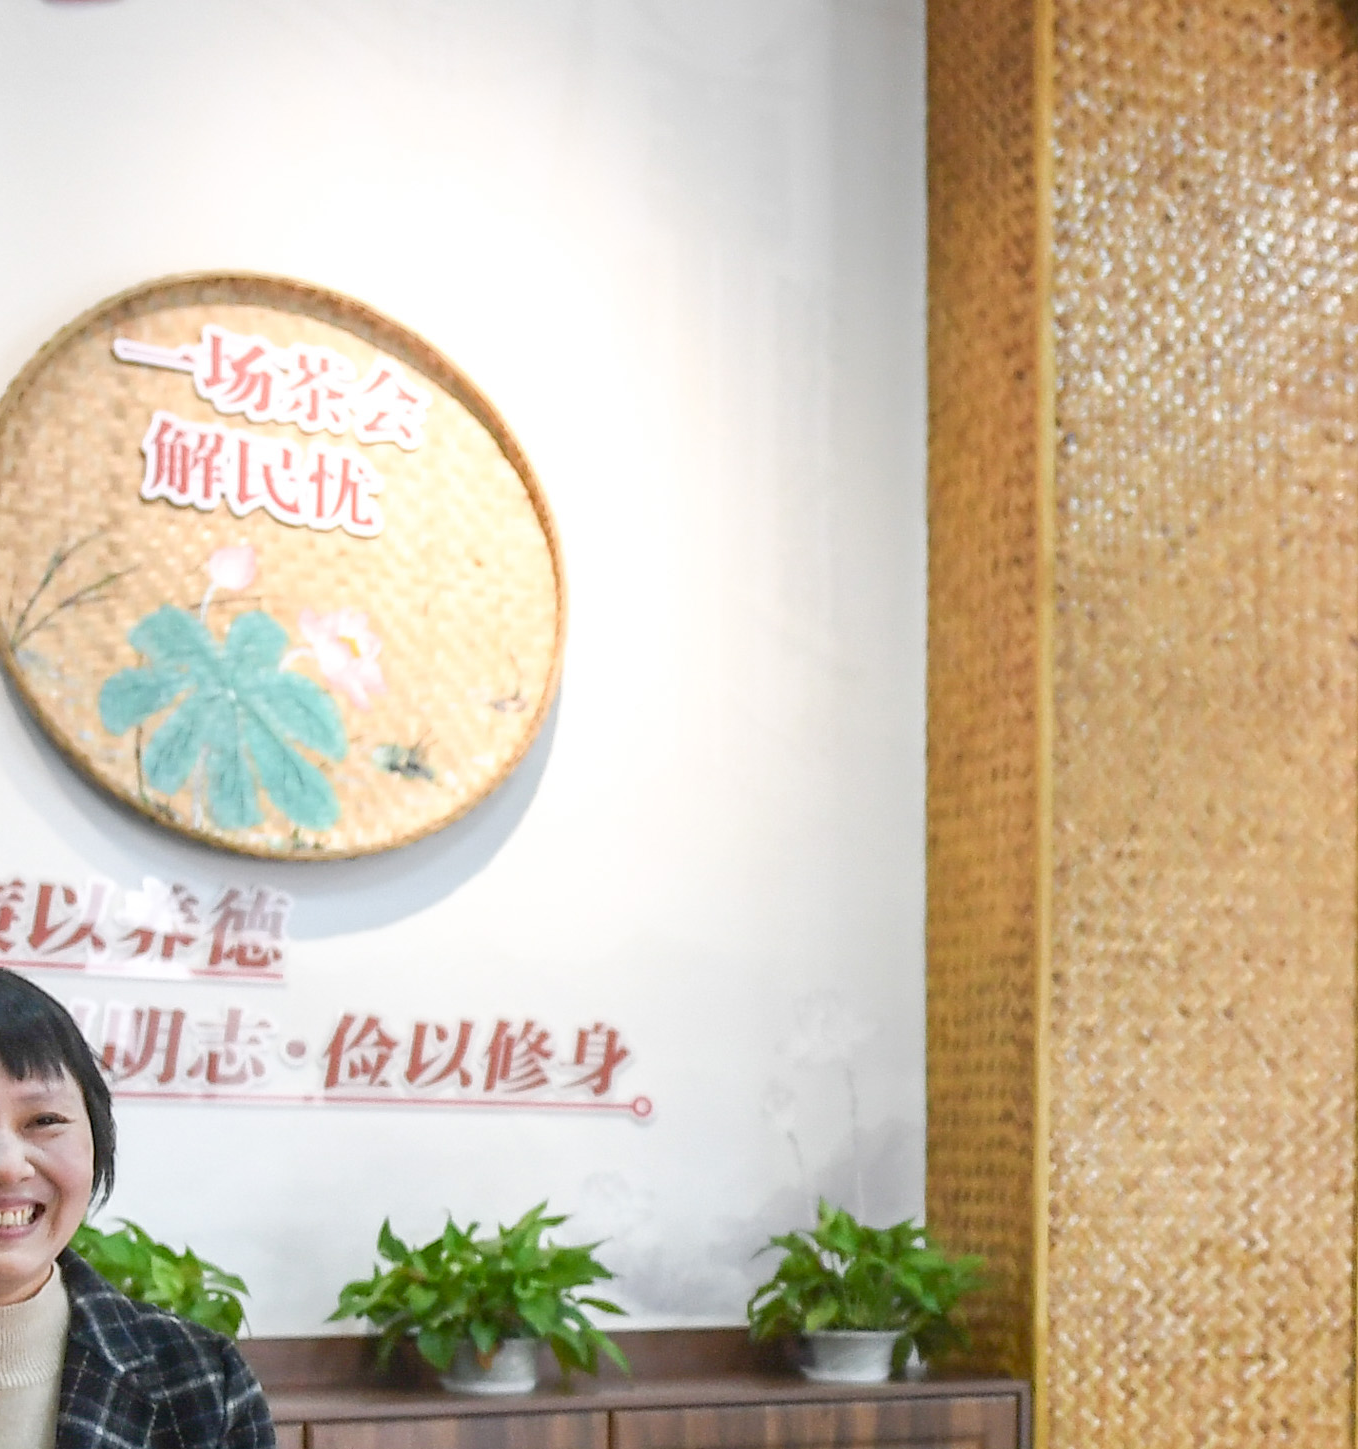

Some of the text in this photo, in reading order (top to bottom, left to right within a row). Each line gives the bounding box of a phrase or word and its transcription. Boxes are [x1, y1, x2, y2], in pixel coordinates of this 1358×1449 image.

[113, 325, 430, 450] 一场茶会
[142, 412, 383, 537] 解民忧
[75, 1003, 630, 1097] 明志·俭以修身
